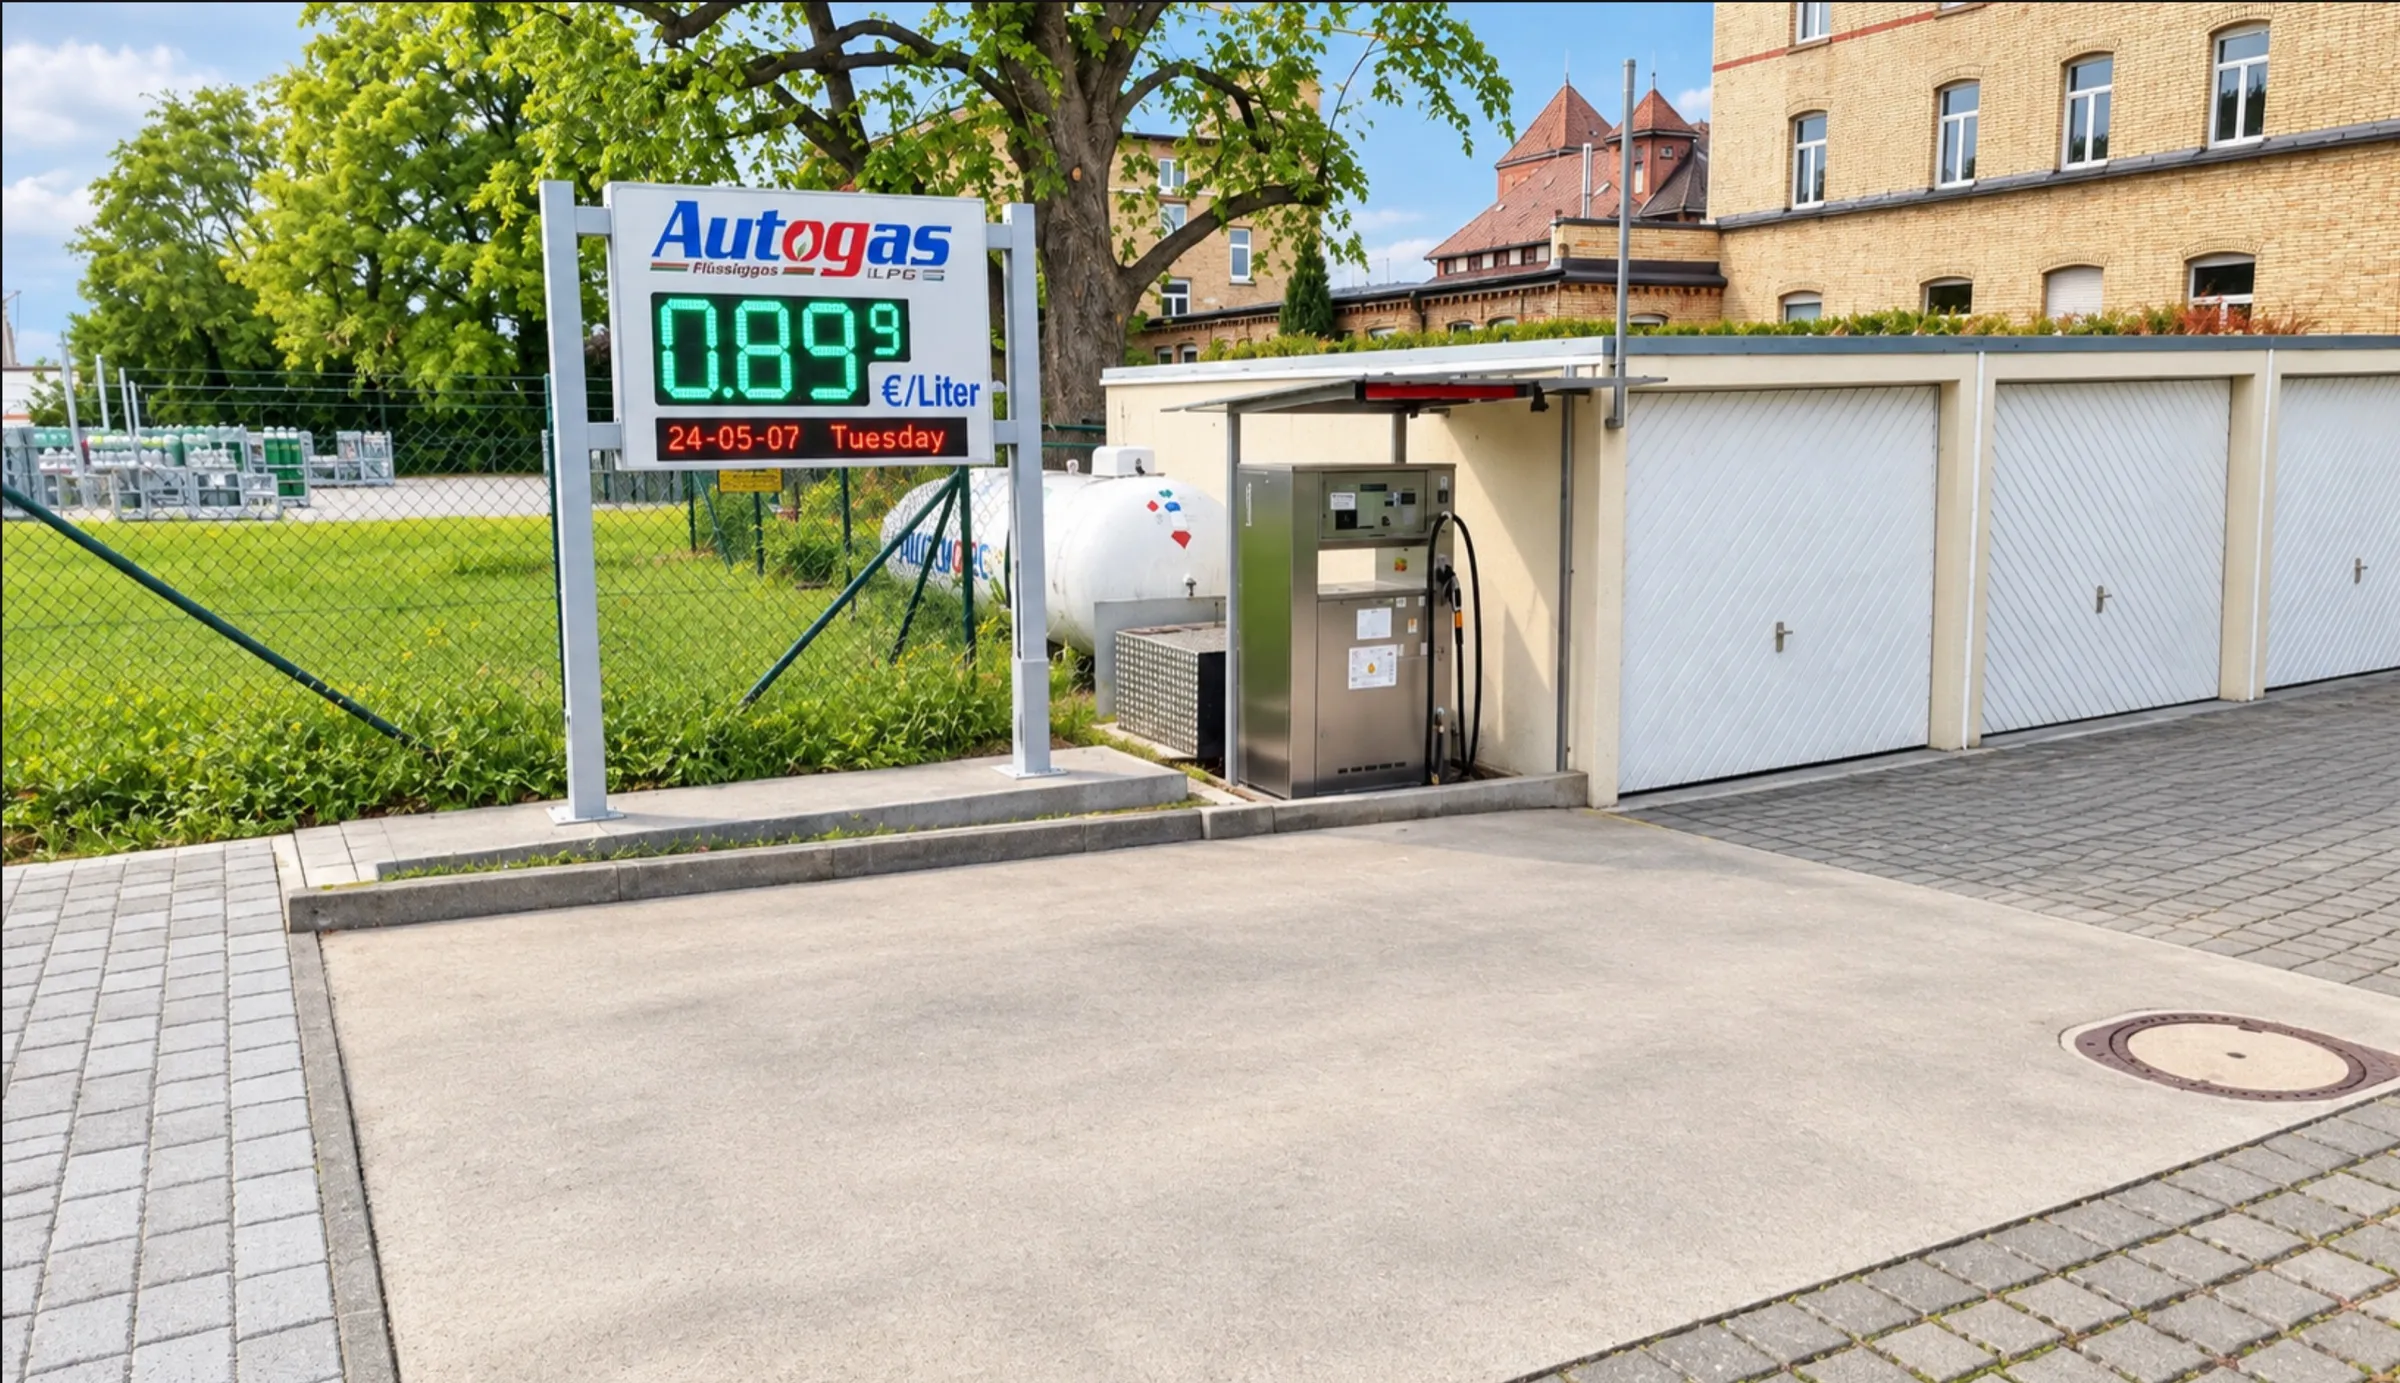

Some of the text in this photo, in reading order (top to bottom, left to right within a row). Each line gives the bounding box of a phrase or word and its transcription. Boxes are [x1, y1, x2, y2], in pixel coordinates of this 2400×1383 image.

[652, 200, 952, 277] Autogas
[882, 374, 980, 407] €/Liter
[669, 425, 944, 454] 24-05-07 Tuesday
